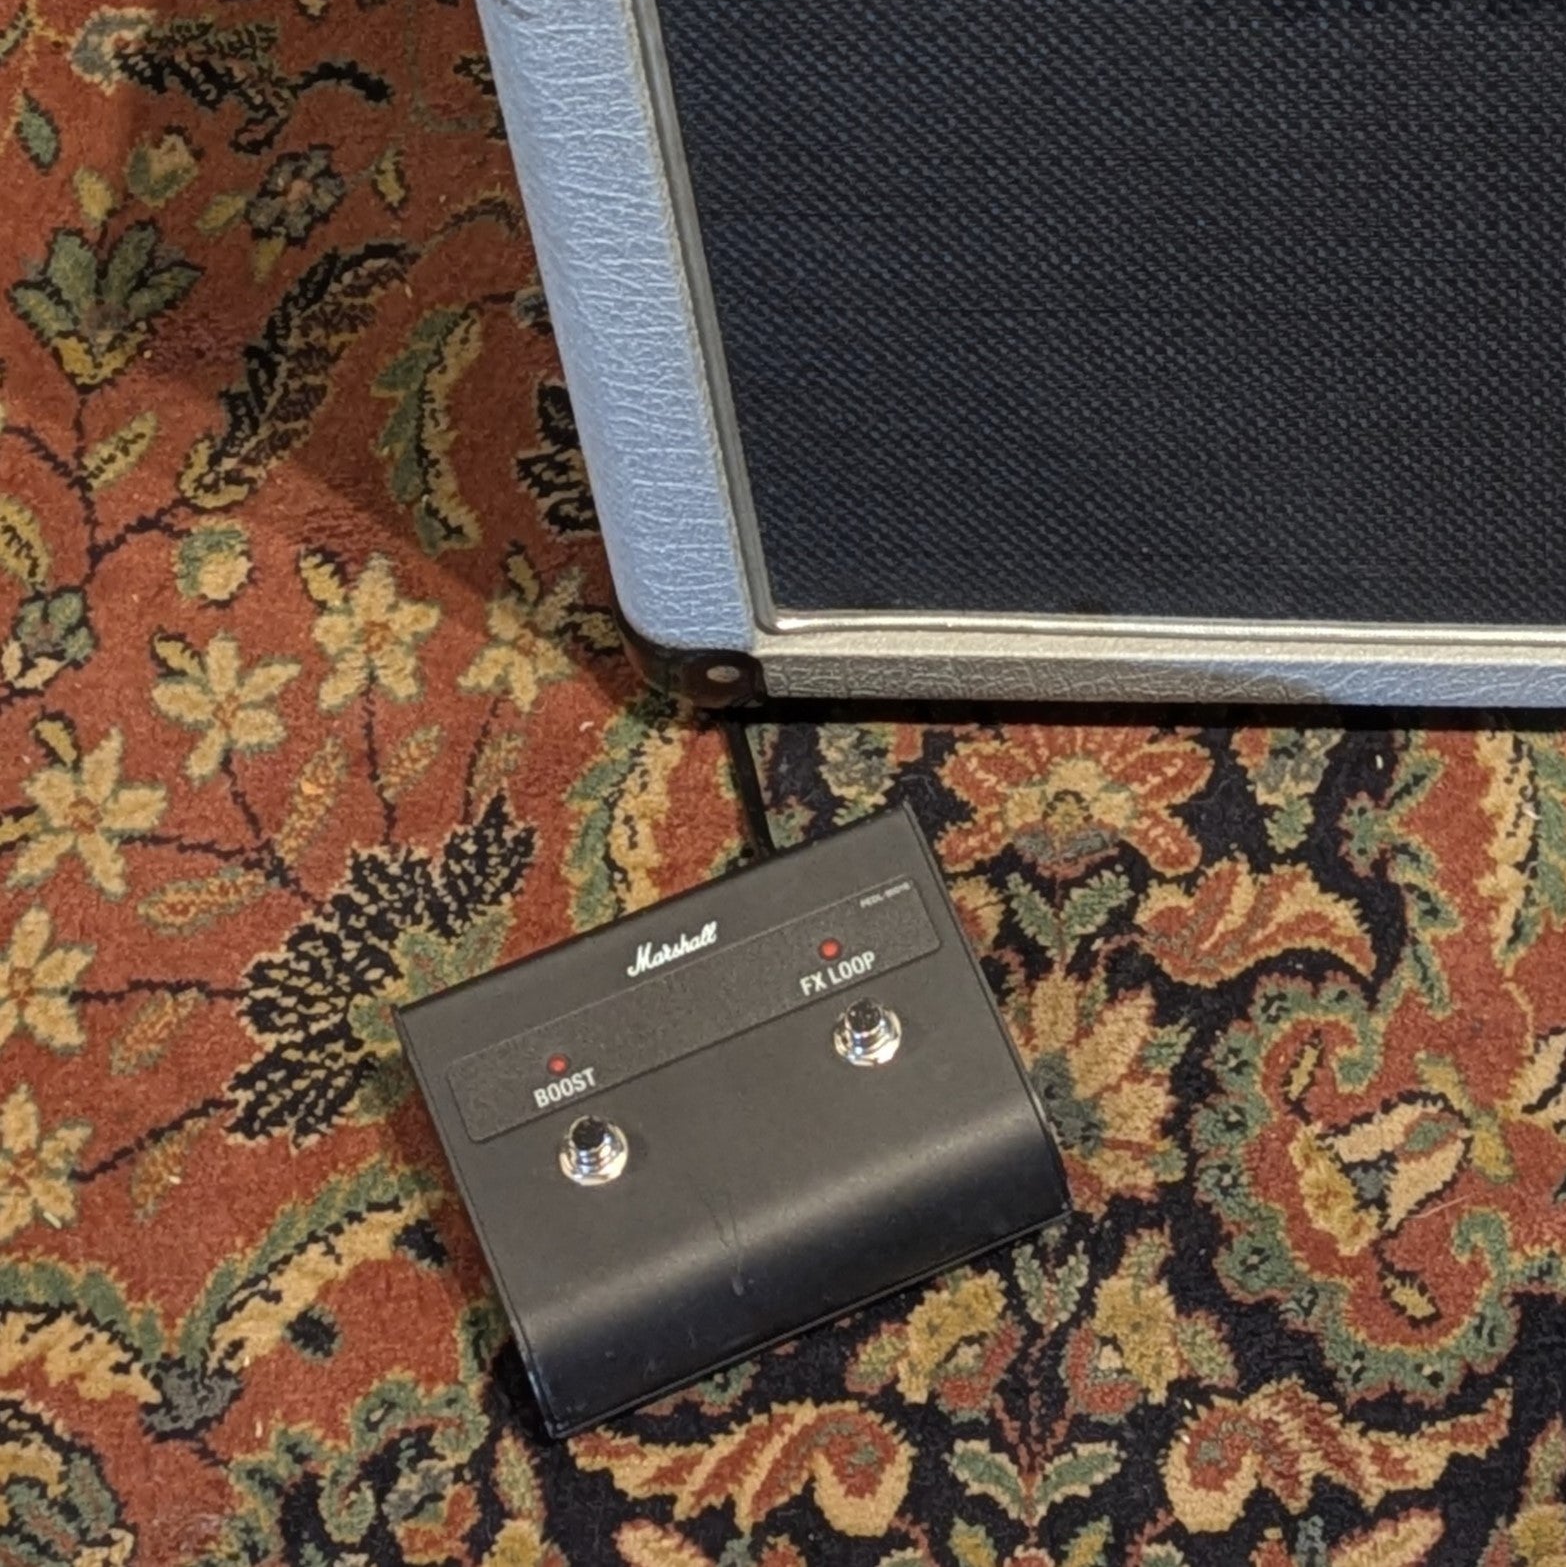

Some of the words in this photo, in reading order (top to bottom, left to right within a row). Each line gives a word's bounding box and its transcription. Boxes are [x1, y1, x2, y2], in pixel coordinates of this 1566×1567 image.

[626, 920, 718, 977] Marshall
[800, 971, 827, 996] FX
[827, 950, 876, 986] LOOP
[533, 1066, 596, 1108] BOOST
